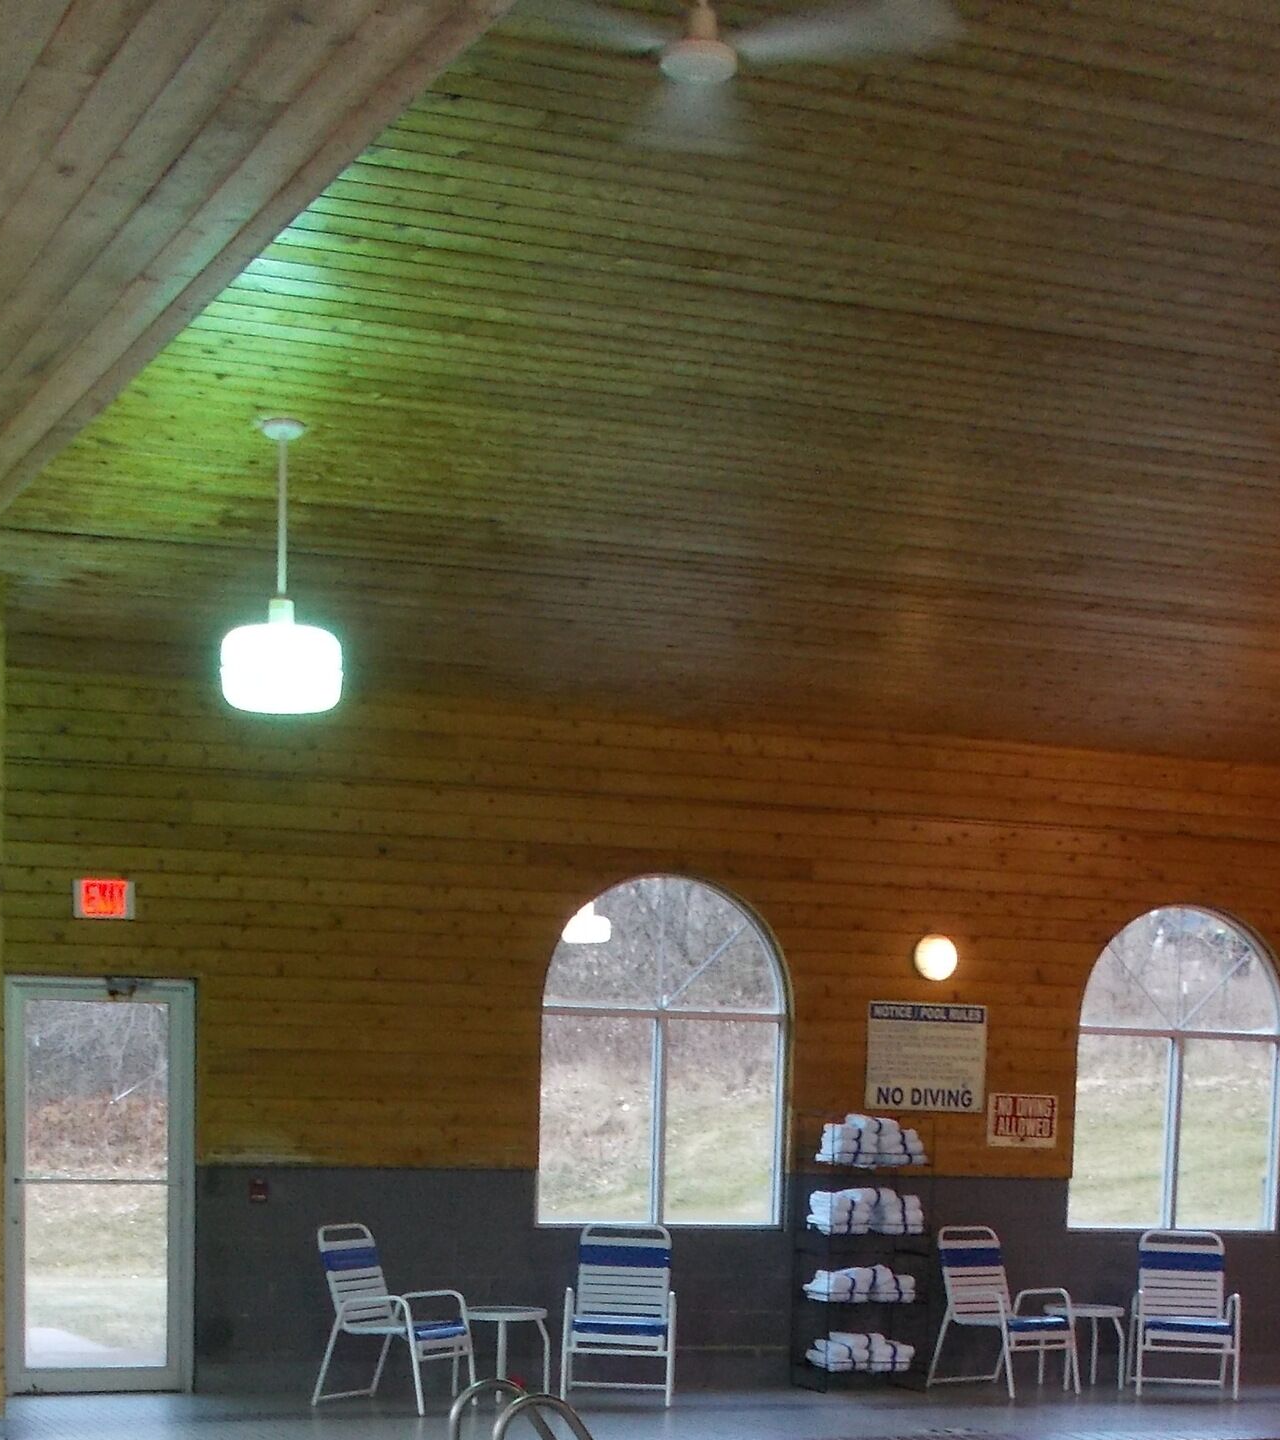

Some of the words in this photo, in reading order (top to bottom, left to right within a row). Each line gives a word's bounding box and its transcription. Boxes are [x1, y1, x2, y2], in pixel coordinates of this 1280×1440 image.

[85, 882, 125, 915] EXIT
[873, 1005, 913, 1018] NOTICE
[920, 1008, 947, 1019] POOL
[949, 1009, 983, 1021] RULES
[876, 1086, 904, 1106] NO
[911, 1088, 973, 1108] DIVING
[997, 1097, 1014, 1116] NO
[1016, 1098, 1052, 1118] DIVING
[997, 1117, 1051, 1137] ALLOWED
